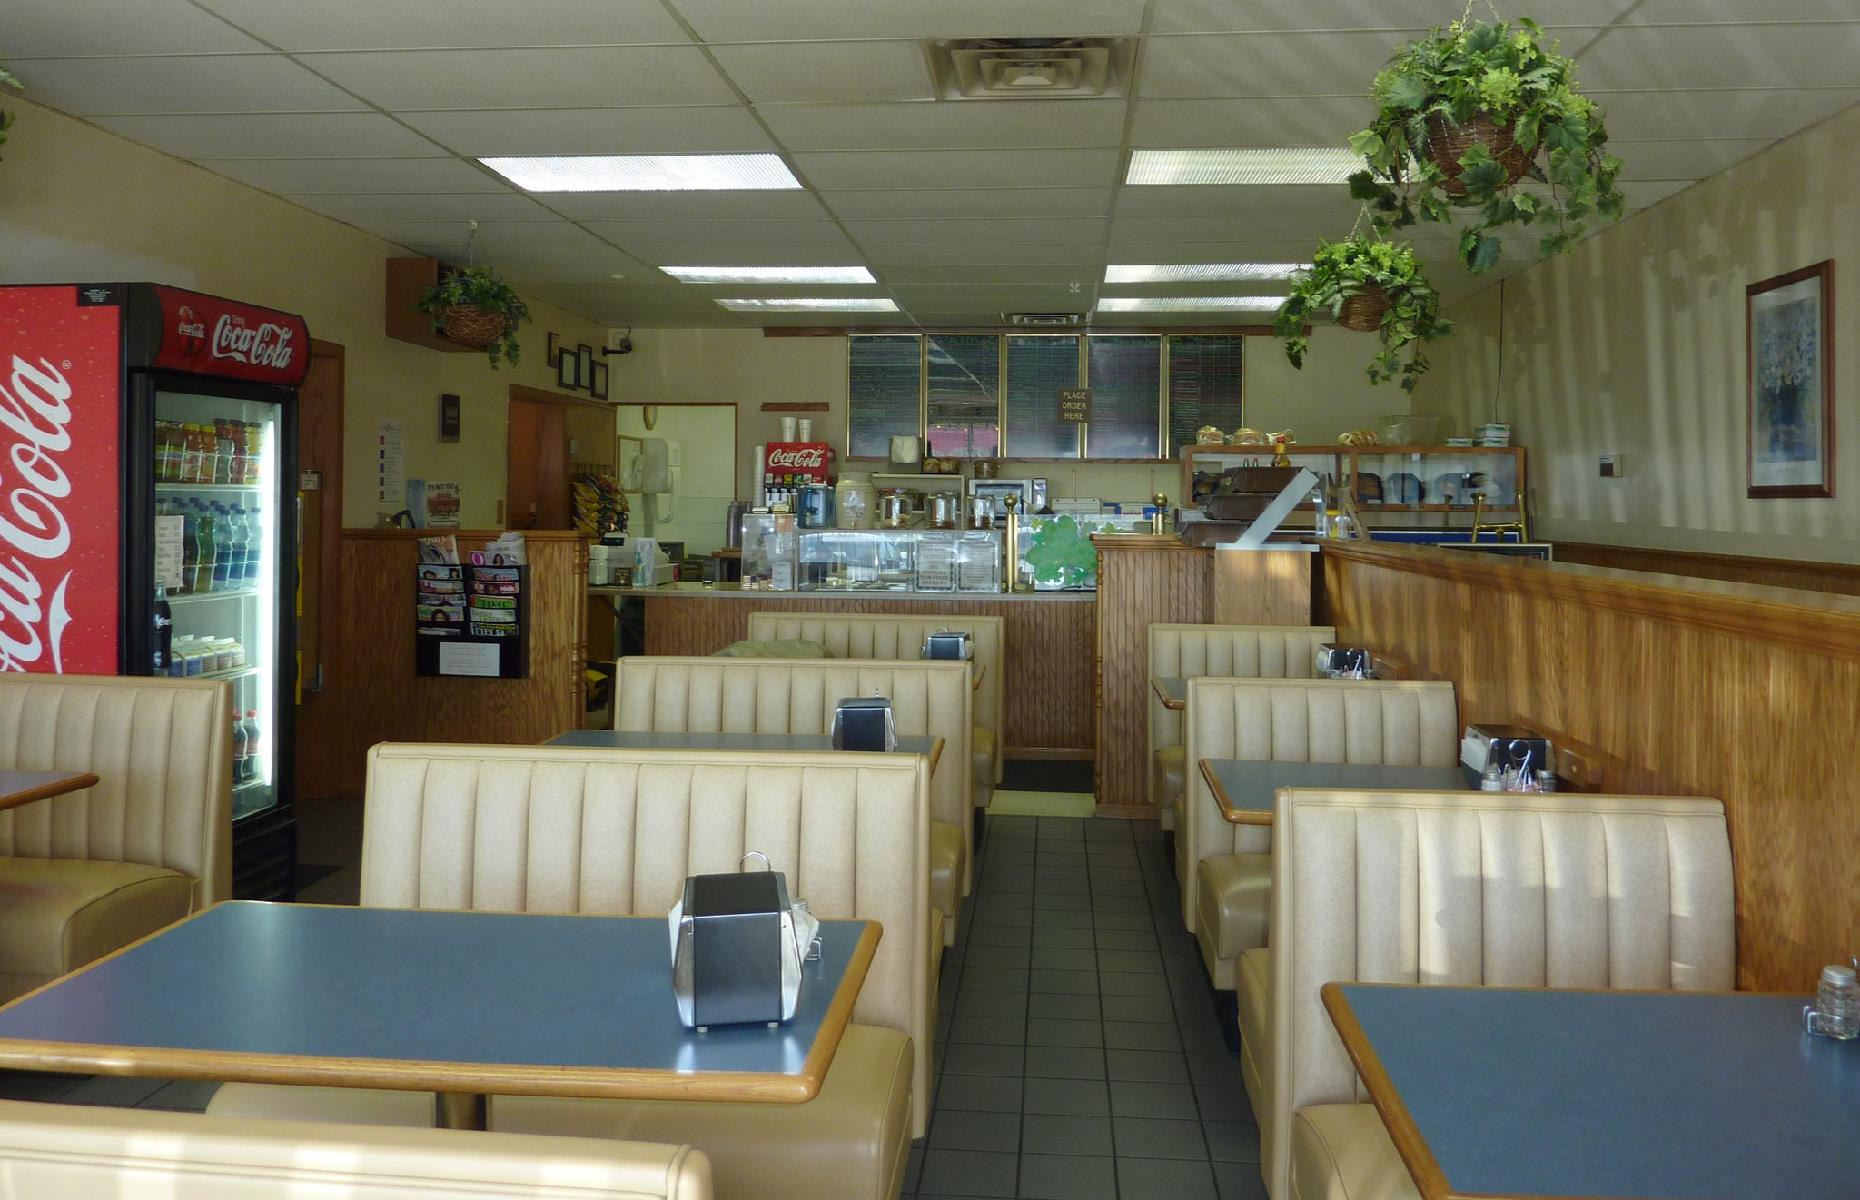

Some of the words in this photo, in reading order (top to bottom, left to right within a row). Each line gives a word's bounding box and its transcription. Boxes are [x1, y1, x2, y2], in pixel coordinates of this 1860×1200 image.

[1063, 391, 1088, 400] PLACE
[1062, 401, 1087, 410] ORDER
[1063, 412, 1084, 420] HERE
[768, 448, 825, 468] Coca-Cola
